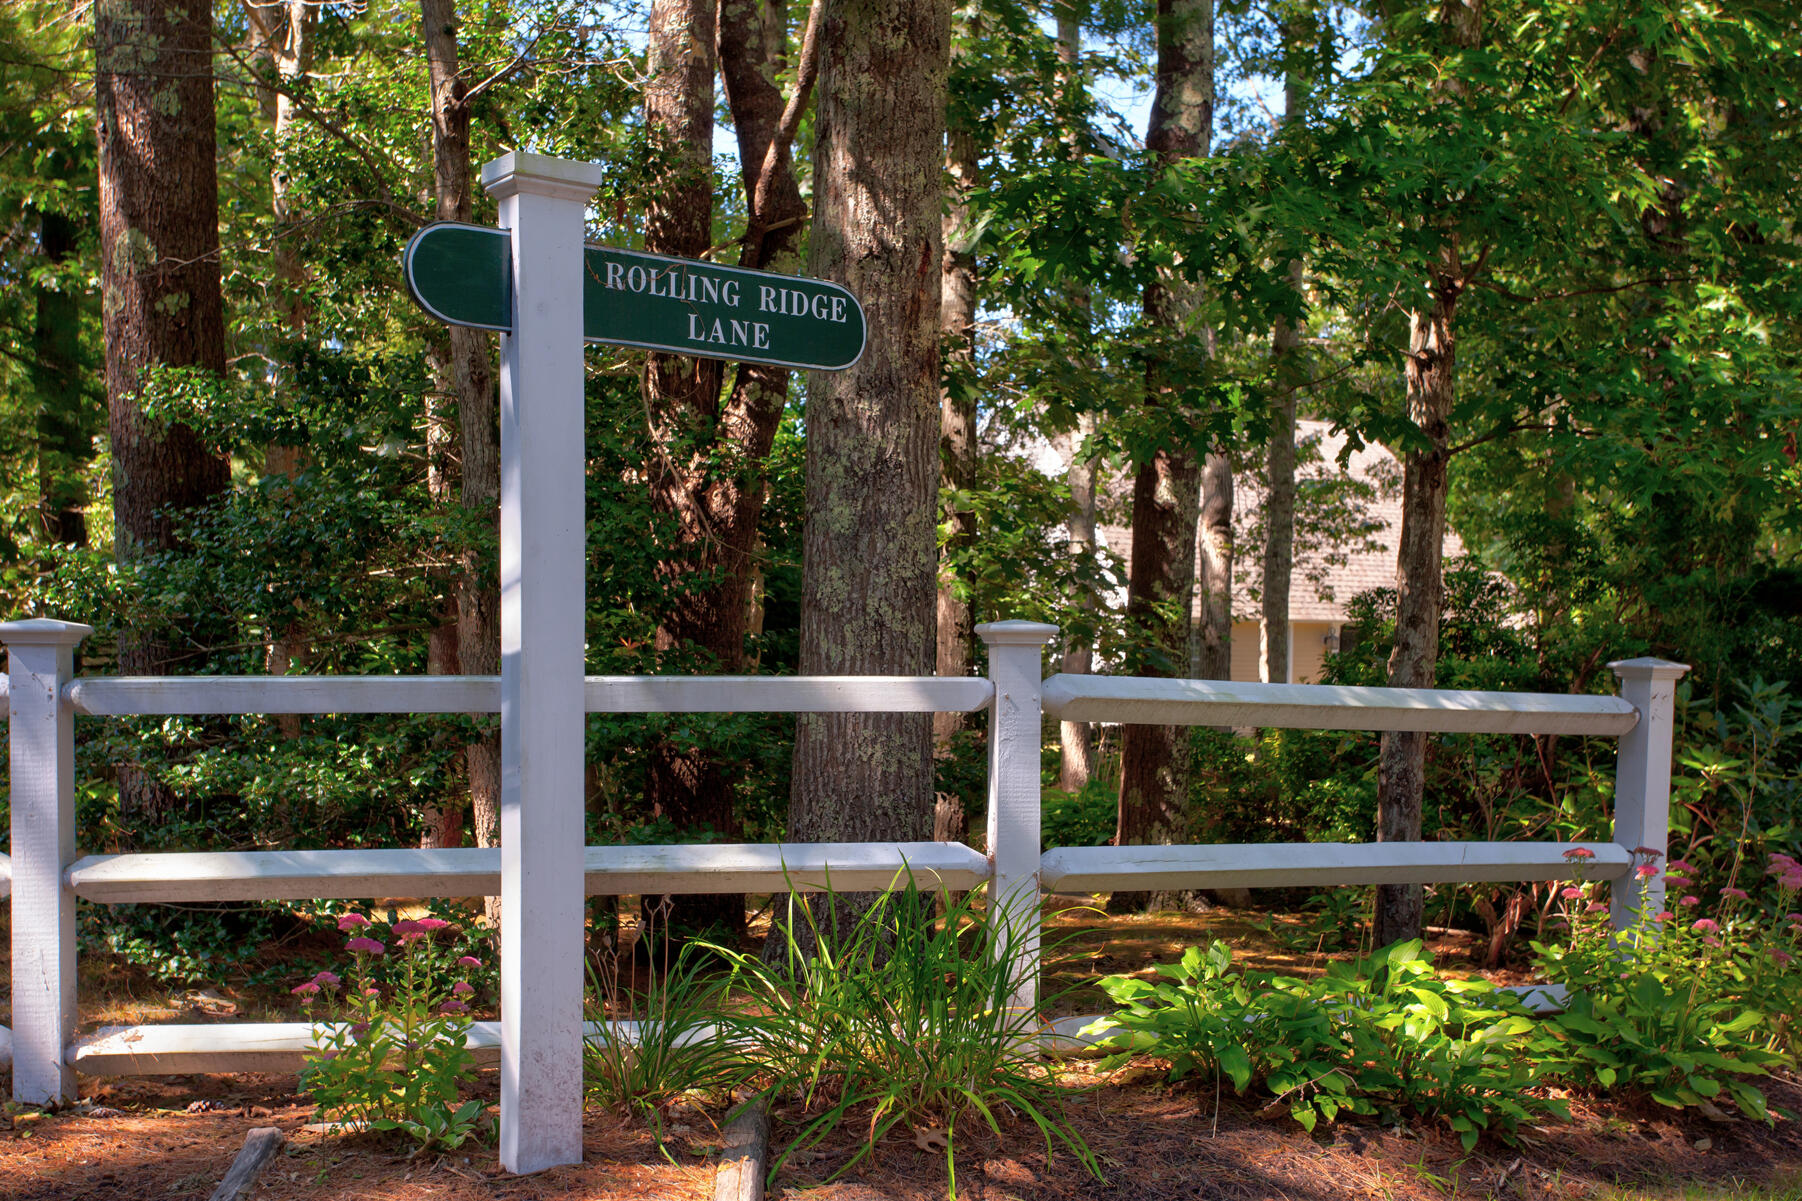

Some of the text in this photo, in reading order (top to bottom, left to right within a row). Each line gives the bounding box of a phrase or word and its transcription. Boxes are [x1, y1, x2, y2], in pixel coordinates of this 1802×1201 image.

[604, 261, 847, 323] ROLLING RIDGE
[687, 313, 770, 350] LANE
